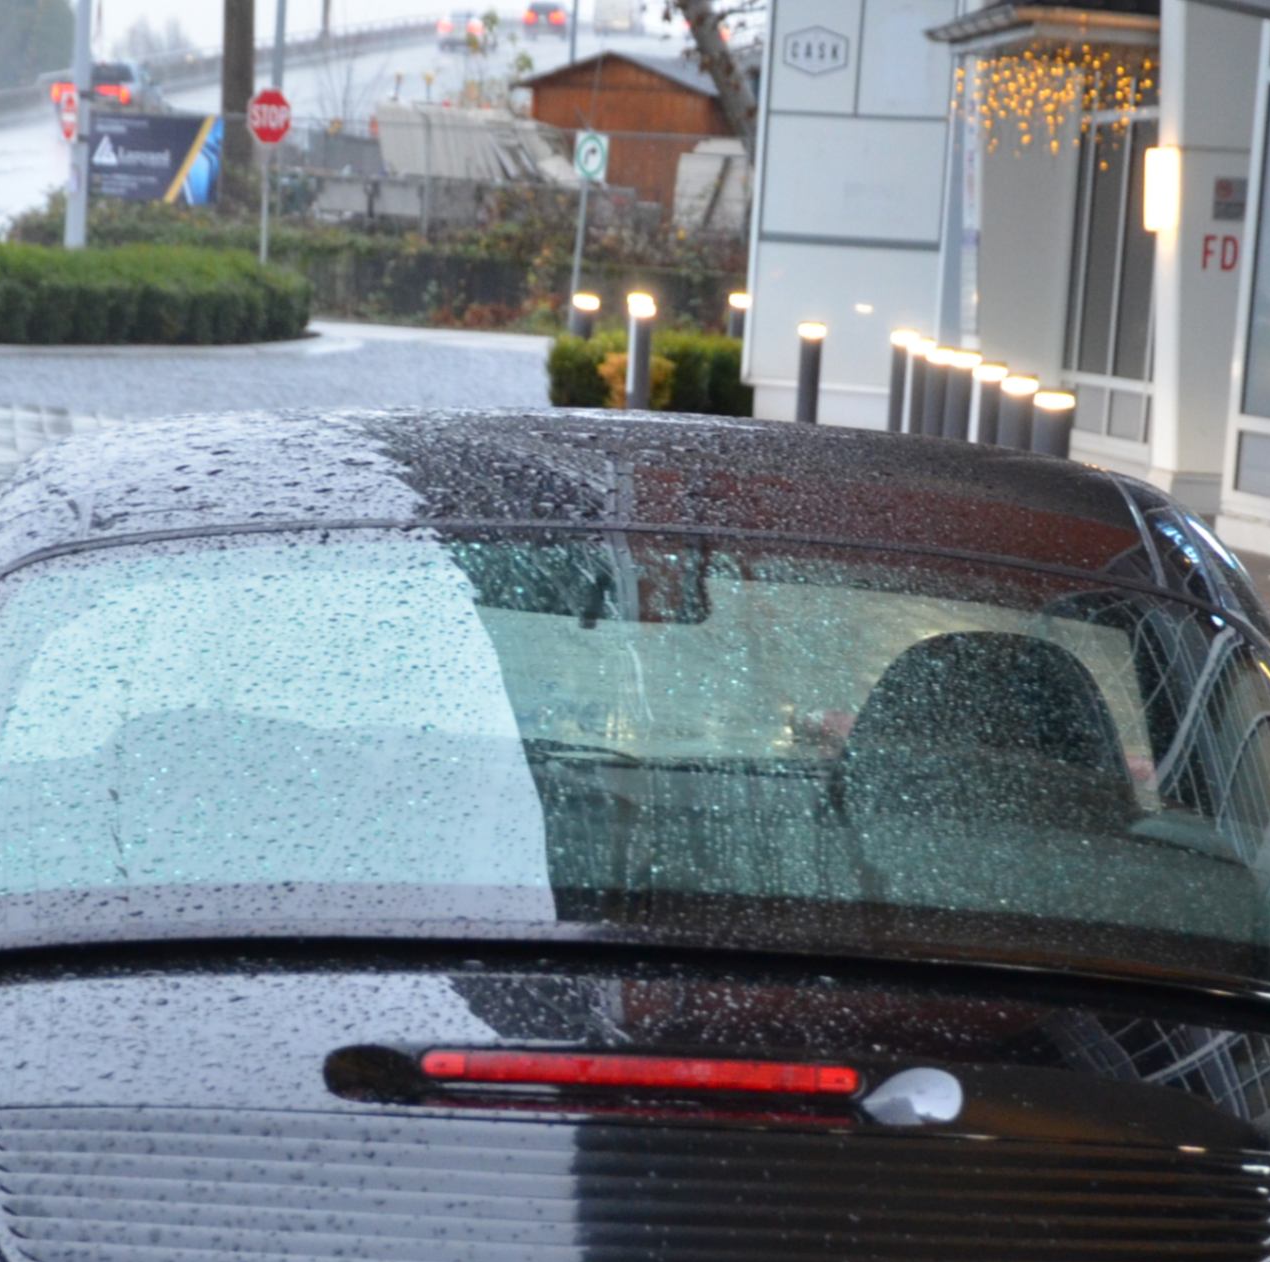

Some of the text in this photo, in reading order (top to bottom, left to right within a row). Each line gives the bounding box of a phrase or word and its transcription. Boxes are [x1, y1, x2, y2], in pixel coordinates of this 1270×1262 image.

[791, 40, 839, 61] CASK
[250, 104, 290, 129] STOP
[1202, 235, 1239, 271] FD
